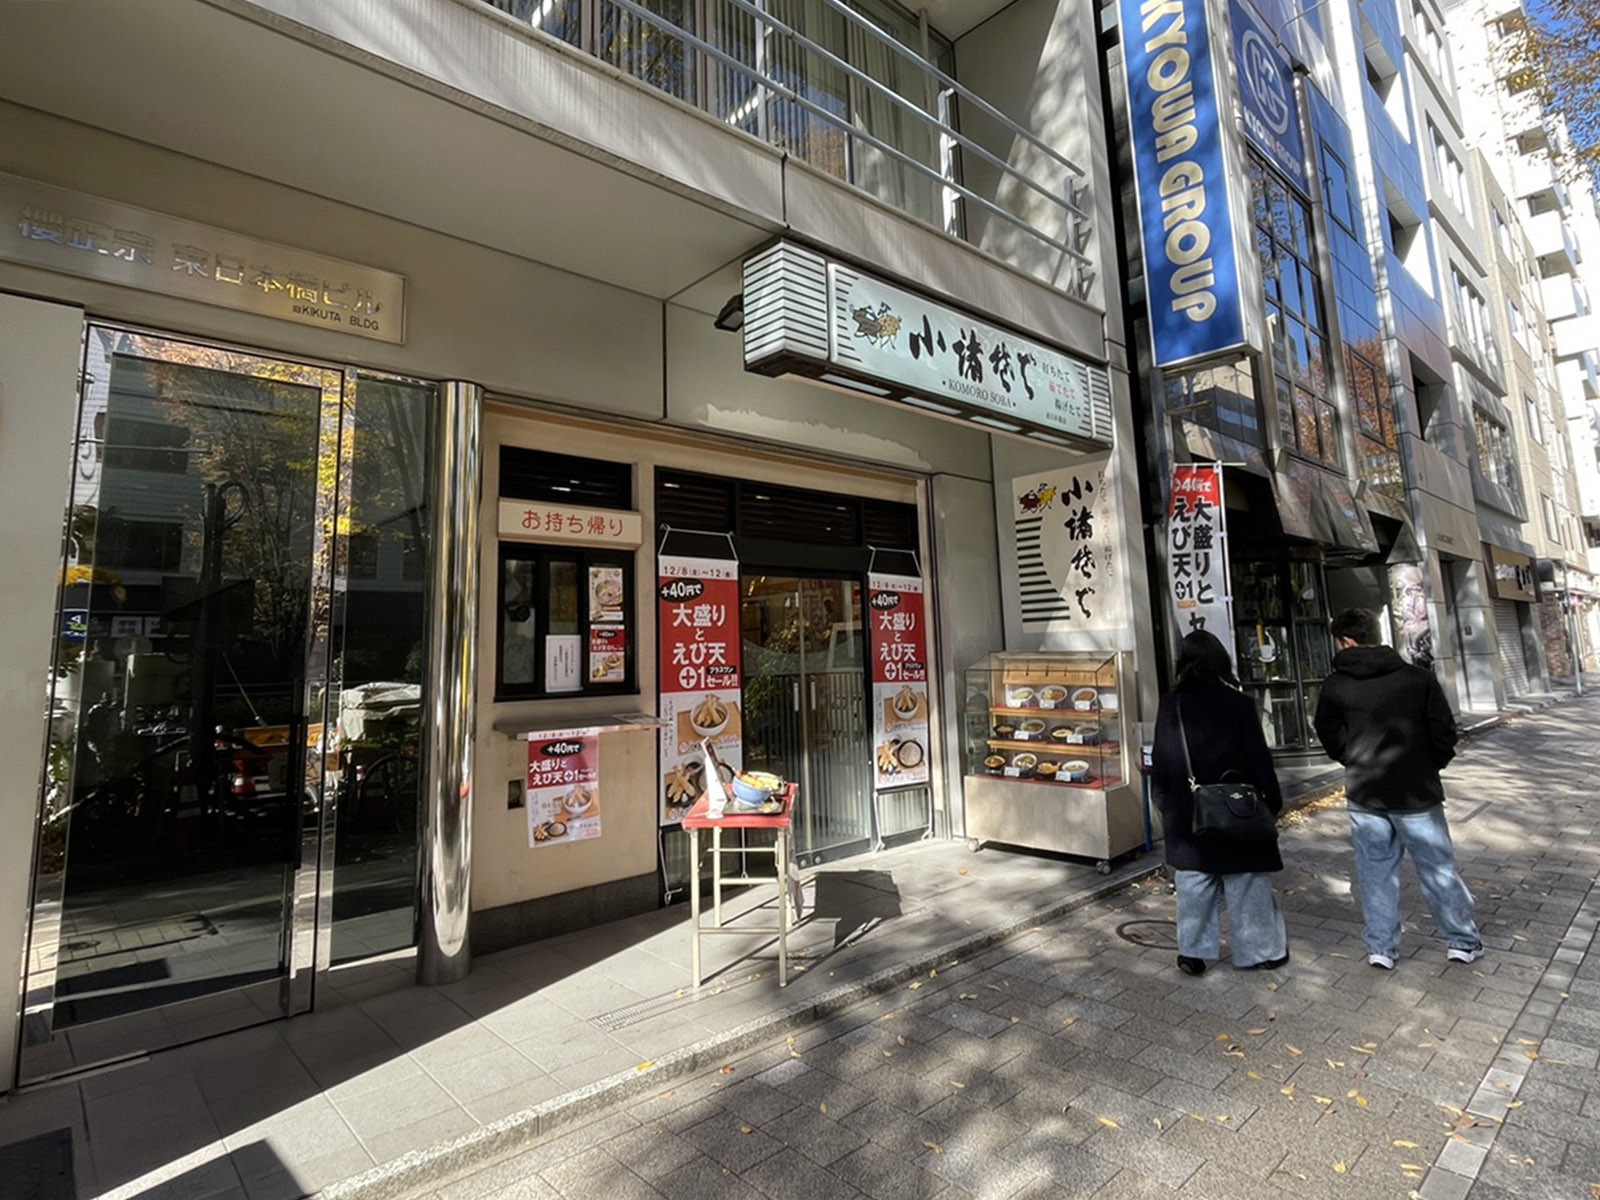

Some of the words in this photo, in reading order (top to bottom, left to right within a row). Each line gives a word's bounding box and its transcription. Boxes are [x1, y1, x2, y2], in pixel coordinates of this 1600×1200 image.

[1140, 0, 1199, 163] KYOWA
[1159, 160, 1217, 323] GROUP
[171, 242, 382, 315] 東日本橋ビル
[349, 315, 379, 331] BLDG
[948, 379, 989, 401] KOMORO
[990, 392, 1012, 408] SOBA
[521, 510, 624, 537] お持ち帰り
[1193, 496, 1215, 605] 大盛りと
[661, 582, 702, 598] +40円で
[672, 604, 726, 627] 大盛り
[879, 611, 915, 631] 大盛り
[694, 627, 705, 641] と
[895, 631, 902, 642] と
[672, 642, 726, 665] えび天
[880, 643, 916, 661] えび天
[529, 758, 567, 773] 大盛りと
